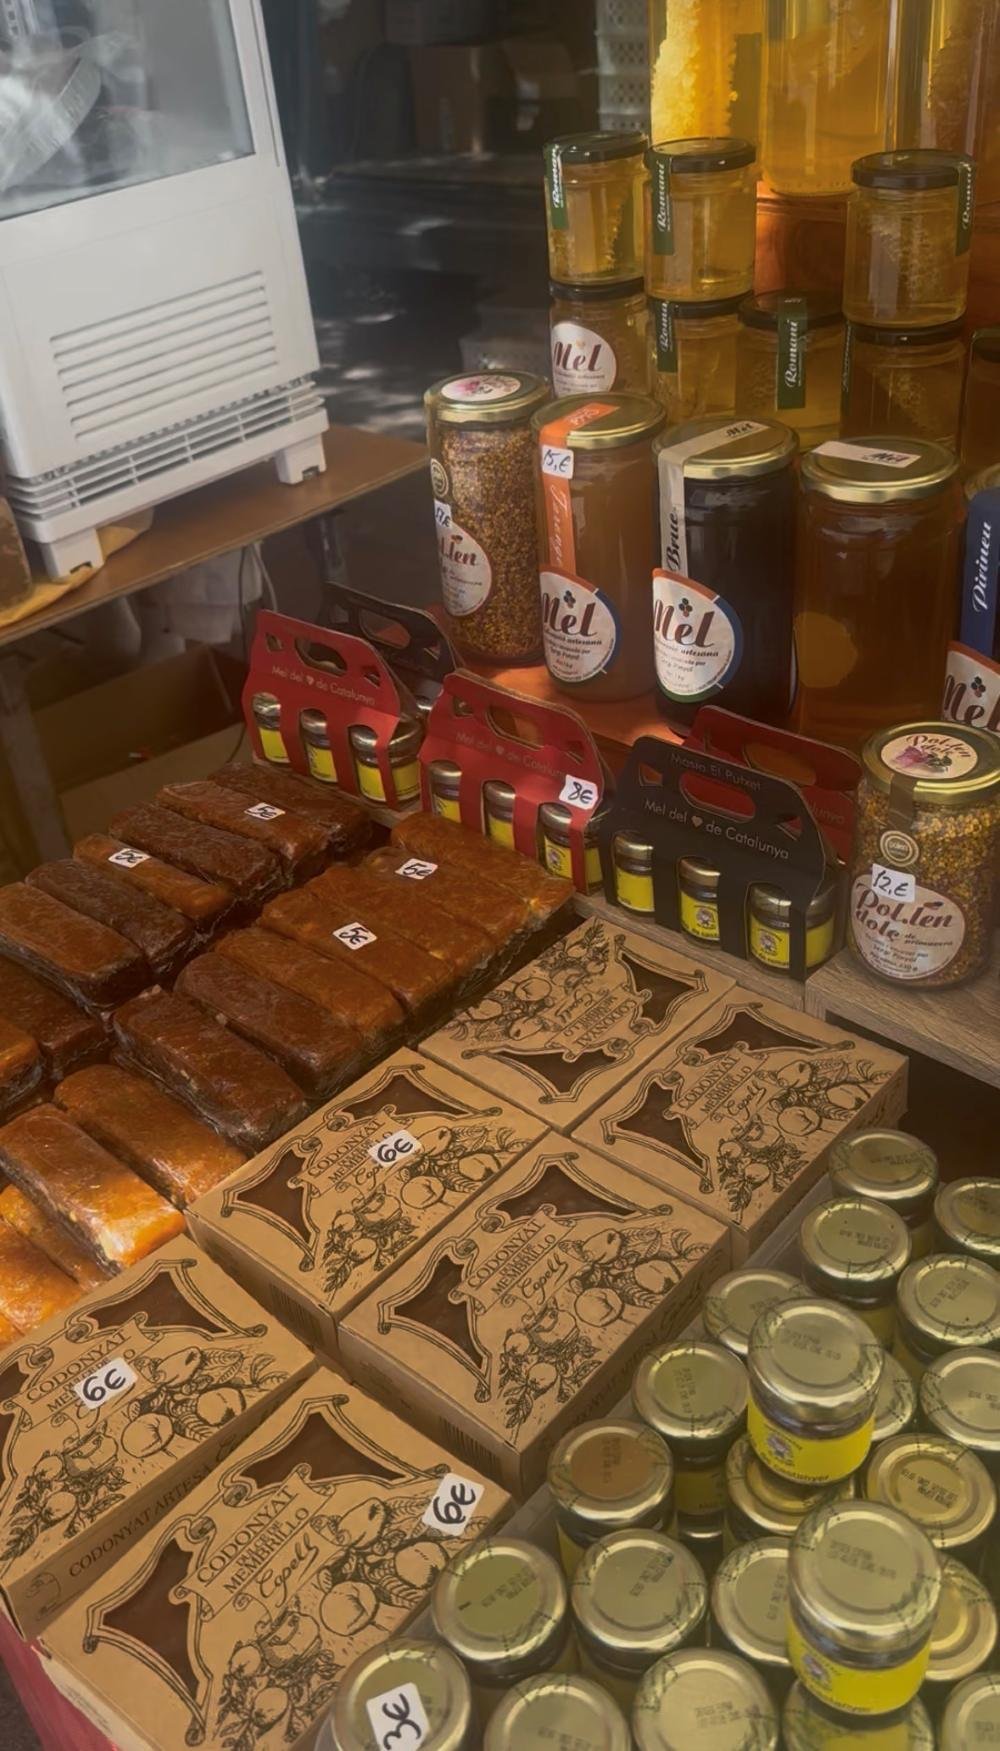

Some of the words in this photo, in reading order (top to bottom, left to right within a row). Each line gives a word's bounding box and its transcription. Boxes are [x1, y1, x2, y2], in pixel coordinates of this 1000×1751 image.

[554, 341, 603, 372] Mel
[972, 521, 992, 612] Pirineu
[655, 599, 715, 648] Mel
[316, 680, 329, 692] de
[330, 682, 376, 706] Catalunya
[567, 781, 594, 804] 8€
[645, 799, 667, 815] Mel
[669, 807, 688, 824] del
[705, 822, 723, 836] de
[725, 826, 789, 861] Catalunya
[677, 1054, 741, 1110] CODONYAT
[307, 1117, 382, 1178] CODONYAT
[377, 1138, 414, 1163] 6€
[467, 1219, 543, 1288] CODONYAT
[26, 1330, 132, 1402] CODONYAT
[82, 1367, 126, 1402] 6€
[433, 1482, 476, 1524] 6€
[69, 1512, 155, 1578] CODONYAT
[196, 1488, 300, 1584] CODONYAT
[223, 1506, 309, 1594] MEMBRILLO
